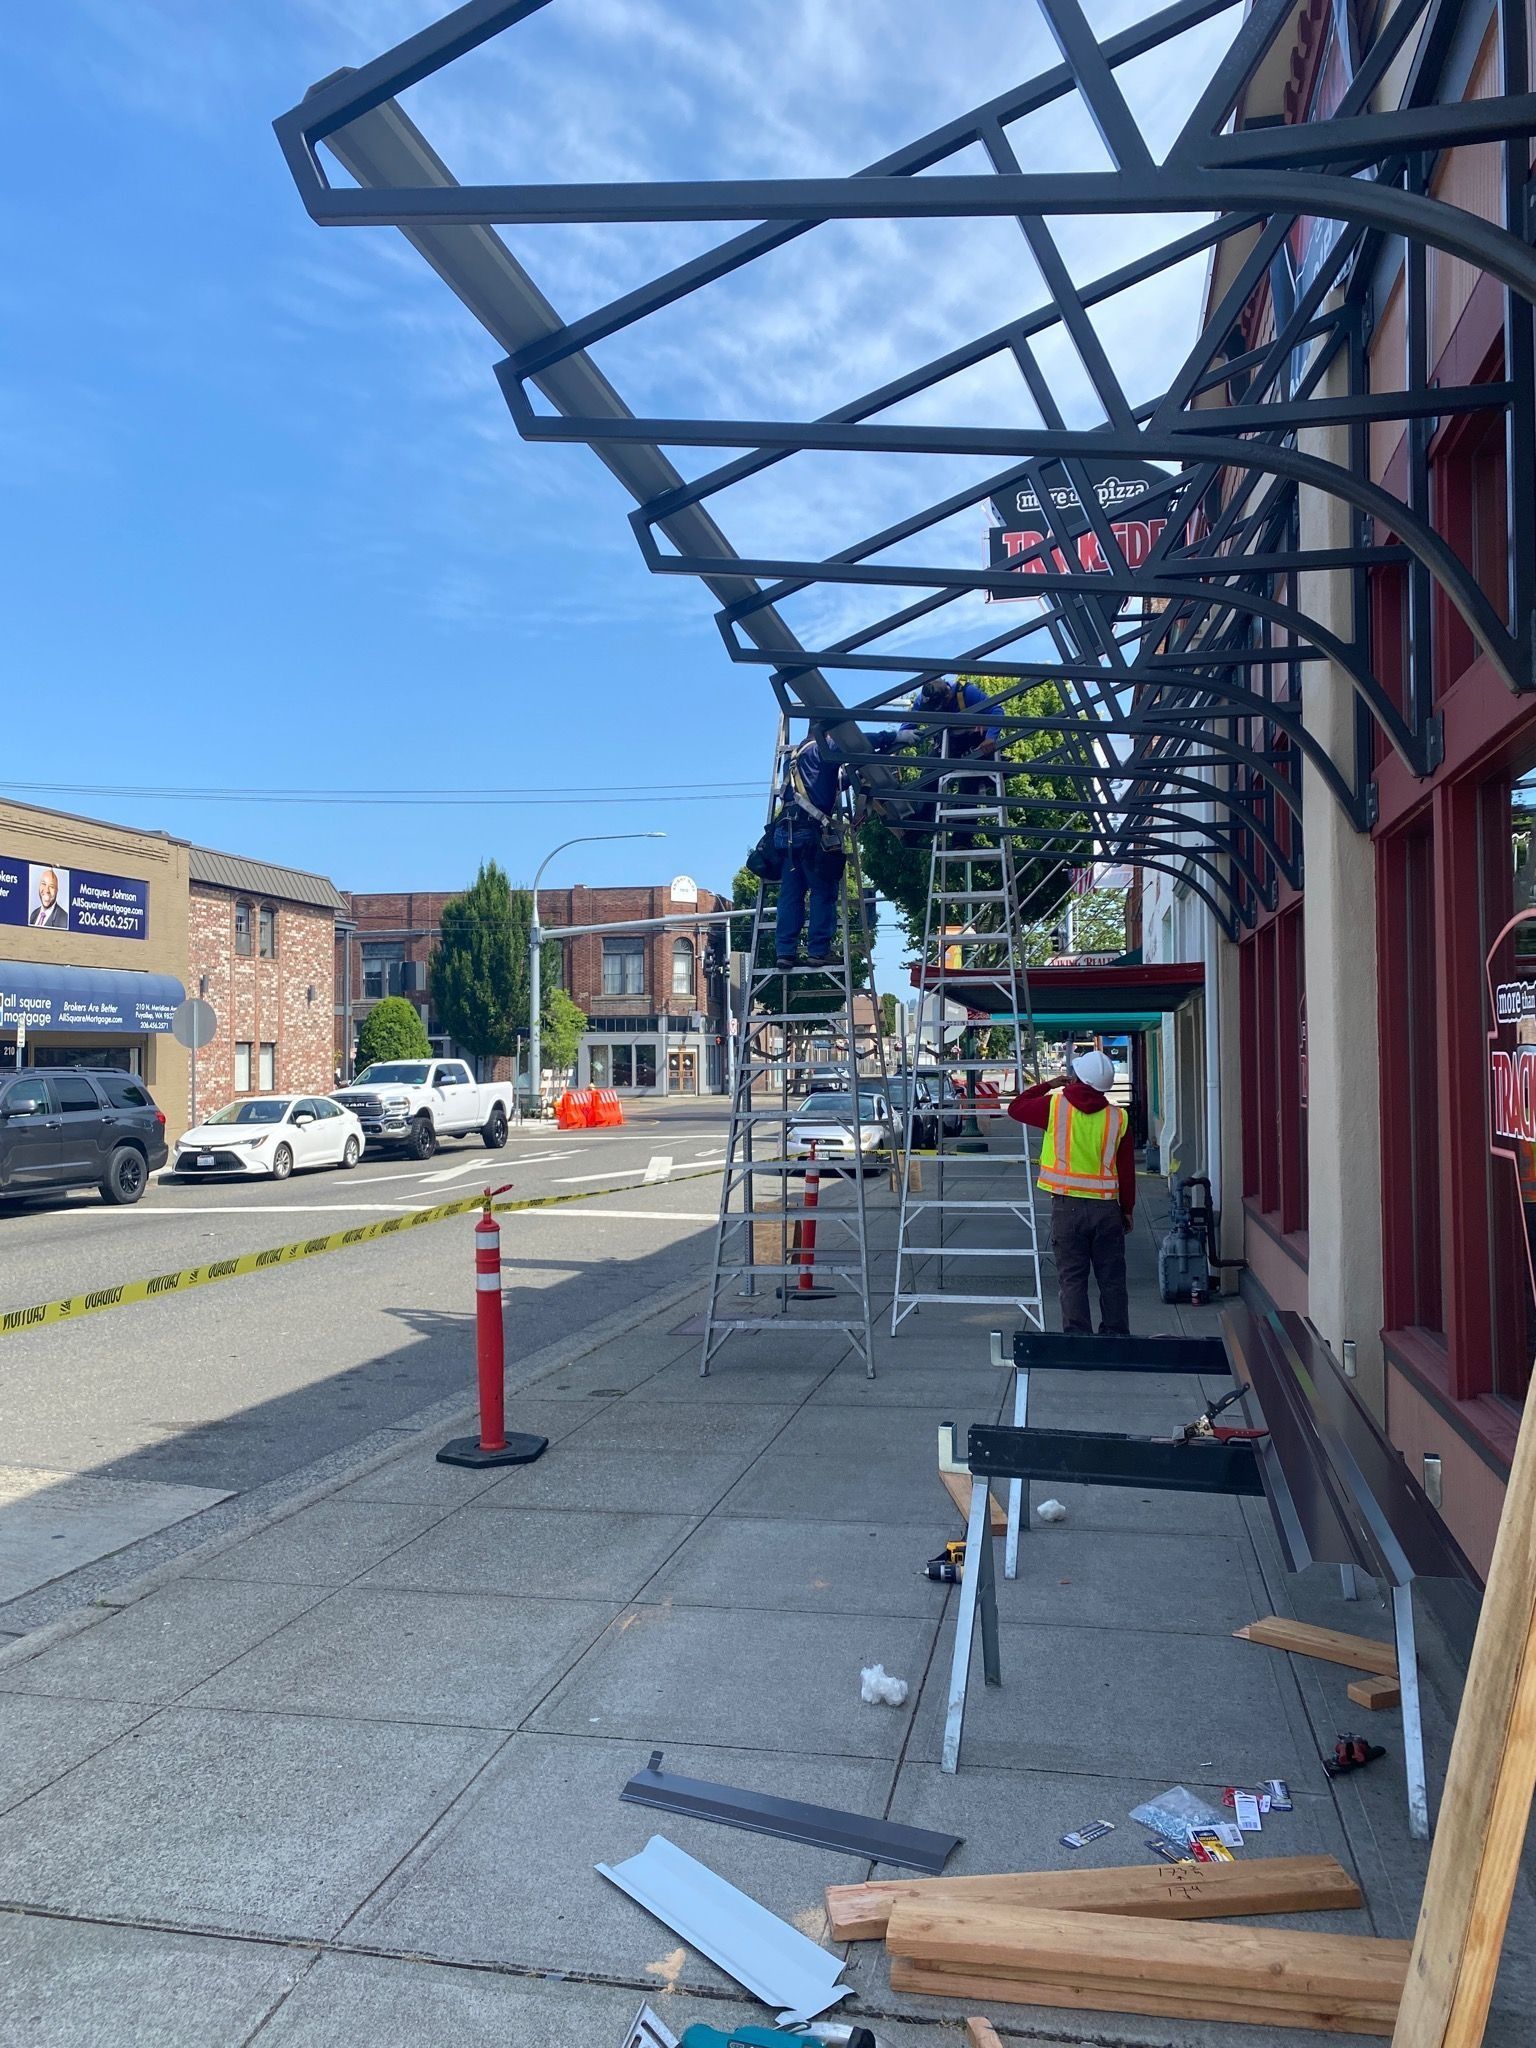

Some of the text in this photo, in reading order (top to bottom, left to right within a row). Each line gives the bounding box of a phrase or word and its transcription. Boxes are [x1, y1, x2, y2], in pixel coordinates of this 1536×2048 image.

[1097, 481, 1145, 505] pizza
[80, 883, 137, 902] Marques Johnson
[72, 897, 144, 916] AllSquareMortgage.com
[78, 911, 139, 931] 206.456.2571
[4, 993, 52, 1012] all square
[63, 1001, 119, 1013] Brokers Are Better
[135, 1003, 145, 1011] 210
[151, 1004, 170, 1012] Meridian
[1498, 989, 1536, 1015] more than
[58, 1012, 123, 1025] AllSquareMortgage.com
[154, 1012, 163, 1020] WA
[3, 1046, 16, 1056] 210
